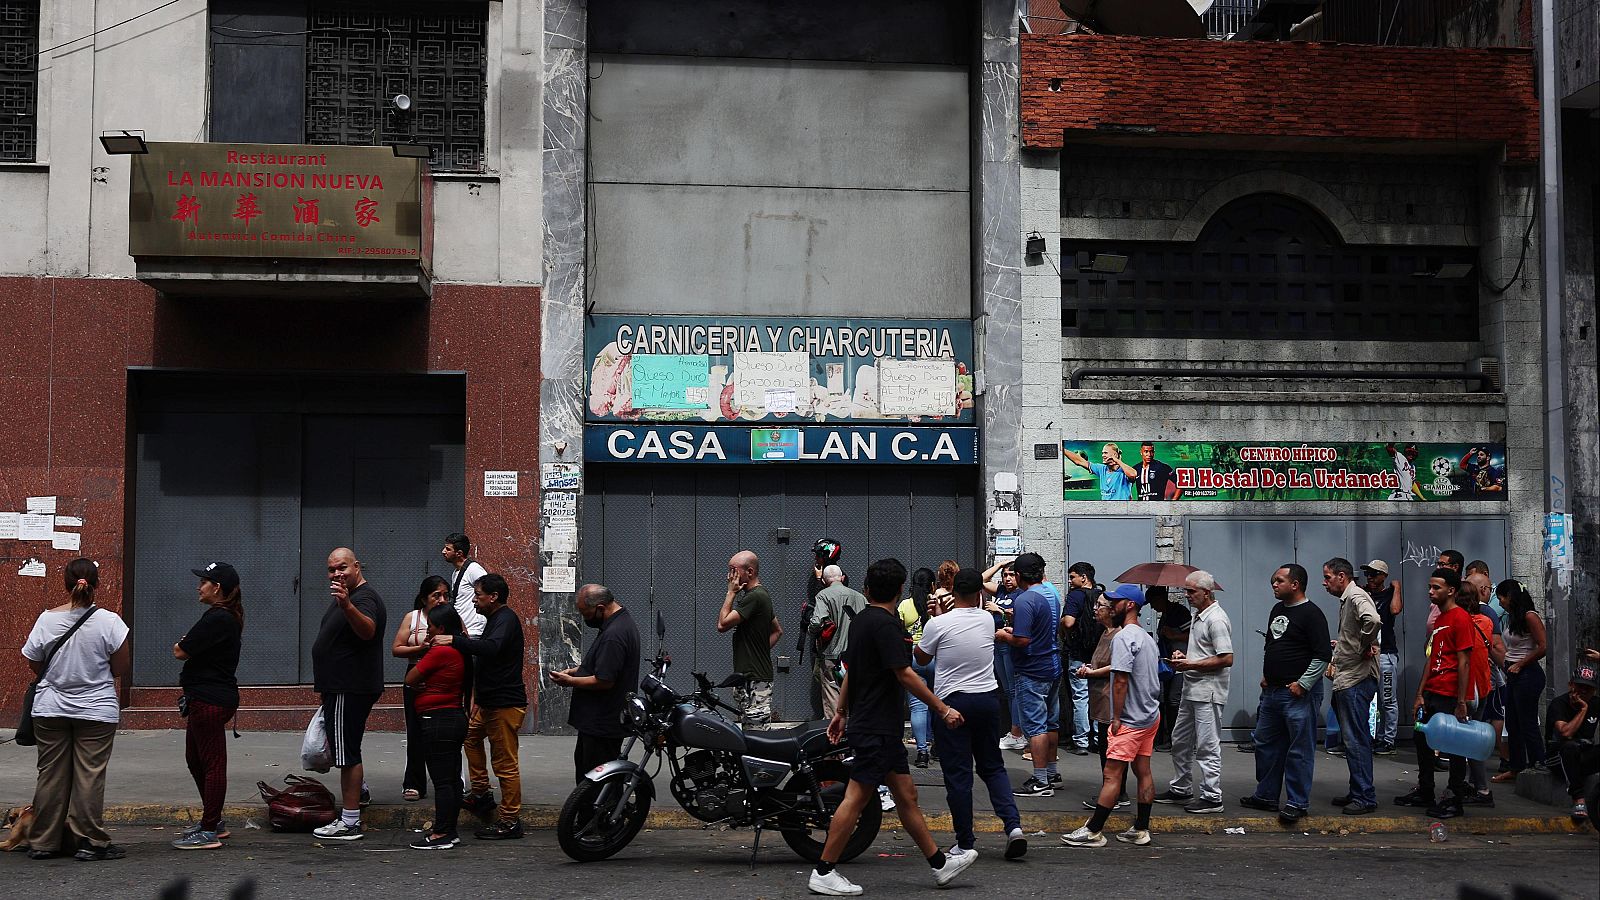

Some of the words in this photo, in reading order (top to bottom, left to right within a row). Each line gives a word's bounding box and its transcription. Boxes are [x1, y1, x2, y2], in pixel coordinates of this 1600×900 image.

[226, 150, 327, 167] Restaurant
[167, 170, 194, 187] LA
[199, 171, 306, 190] MANSION
[311, 173, 384, 192] NUEVA
[261, 231, 313, 243] Comida
[317, 232, 356, 244] China
[616, 324, 761, 356] CARNICERIA
[766, 326, 784, 352] Y
[788, 327, 955, 357] CHARCUTERIA
[607, 430, 727, 460] CASA
[891, 432, 961, 461] C.A
[1240, 447, 1290, 461] CENTRO
[1292, 444, 1337, 461] HÍPICO
[1176, 468, 1196, 488] El
[1198, 468, 1259, 488] Hostal
[1261, 468, 1287, 488] De
[1288, 468, 1313, 488] La
[1315, 468, 1400, 488] Urdaneta
